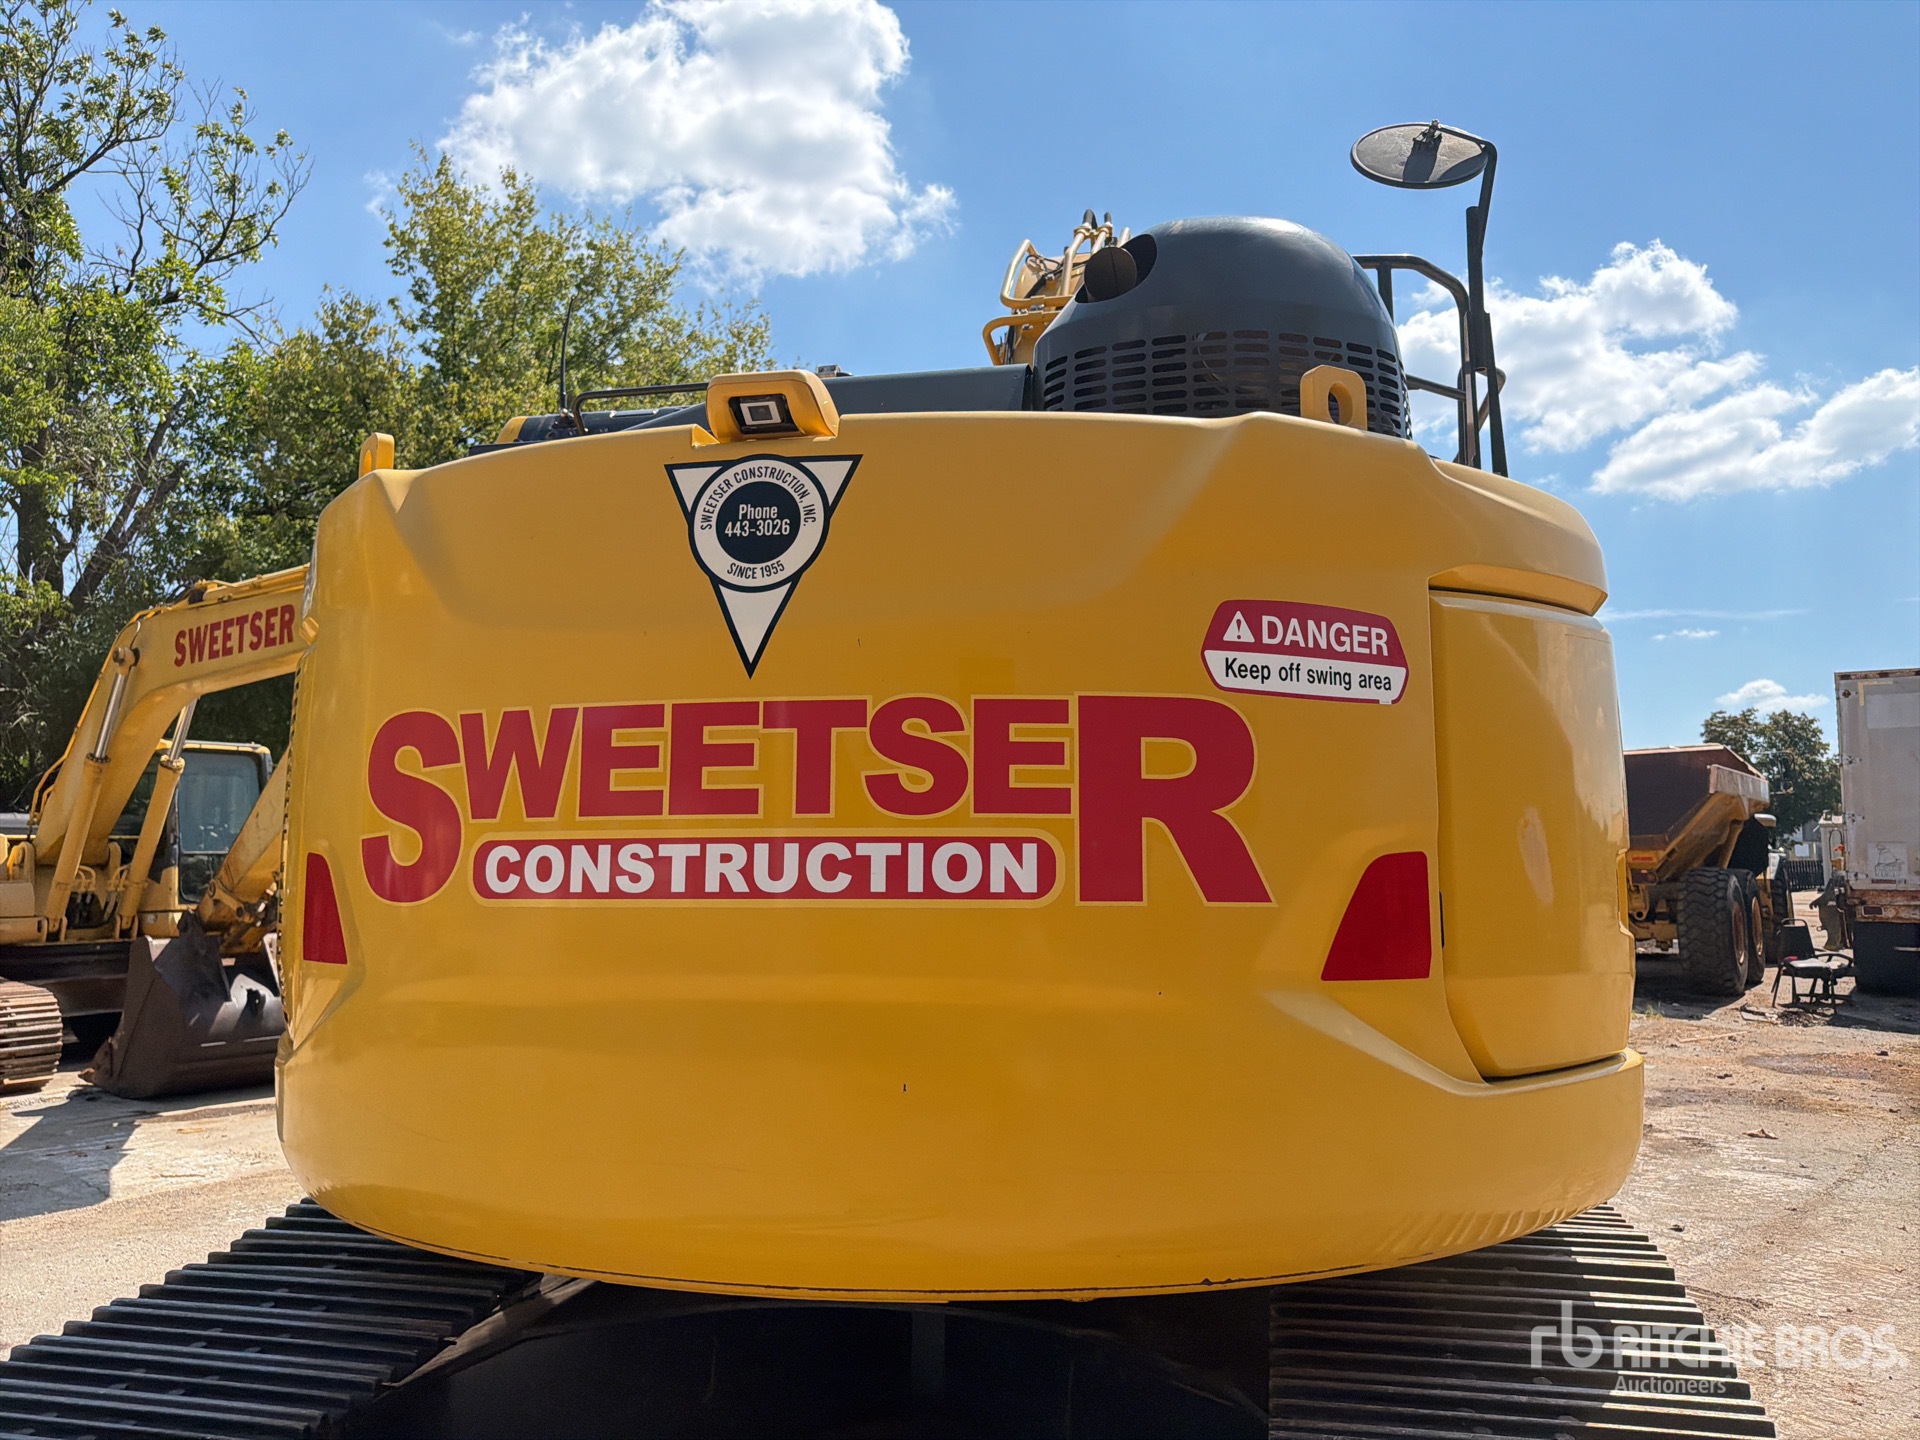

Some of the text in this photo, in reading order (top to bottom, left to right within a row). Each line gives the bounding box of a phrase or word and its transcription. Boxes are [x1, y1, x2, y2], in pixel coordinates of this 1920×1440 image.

[700, 465, 817, 531] SWEETSER CONSTRUCTION, INC.
[738, 503, 778, 520] Phone
[724, 519, 791, 537] 443-3026
[727, 560, 785, 580] SINCE 1955
[174, 604, 295, 667] SWEETSER
[1261, 614, 1389, 657] DANGER
[1225, 657, 1392, 691] Keep off swing area
[361, 693, 1272, 903] SWEETSER
[485, 842, 1039, 895] CONSTRUCTION
